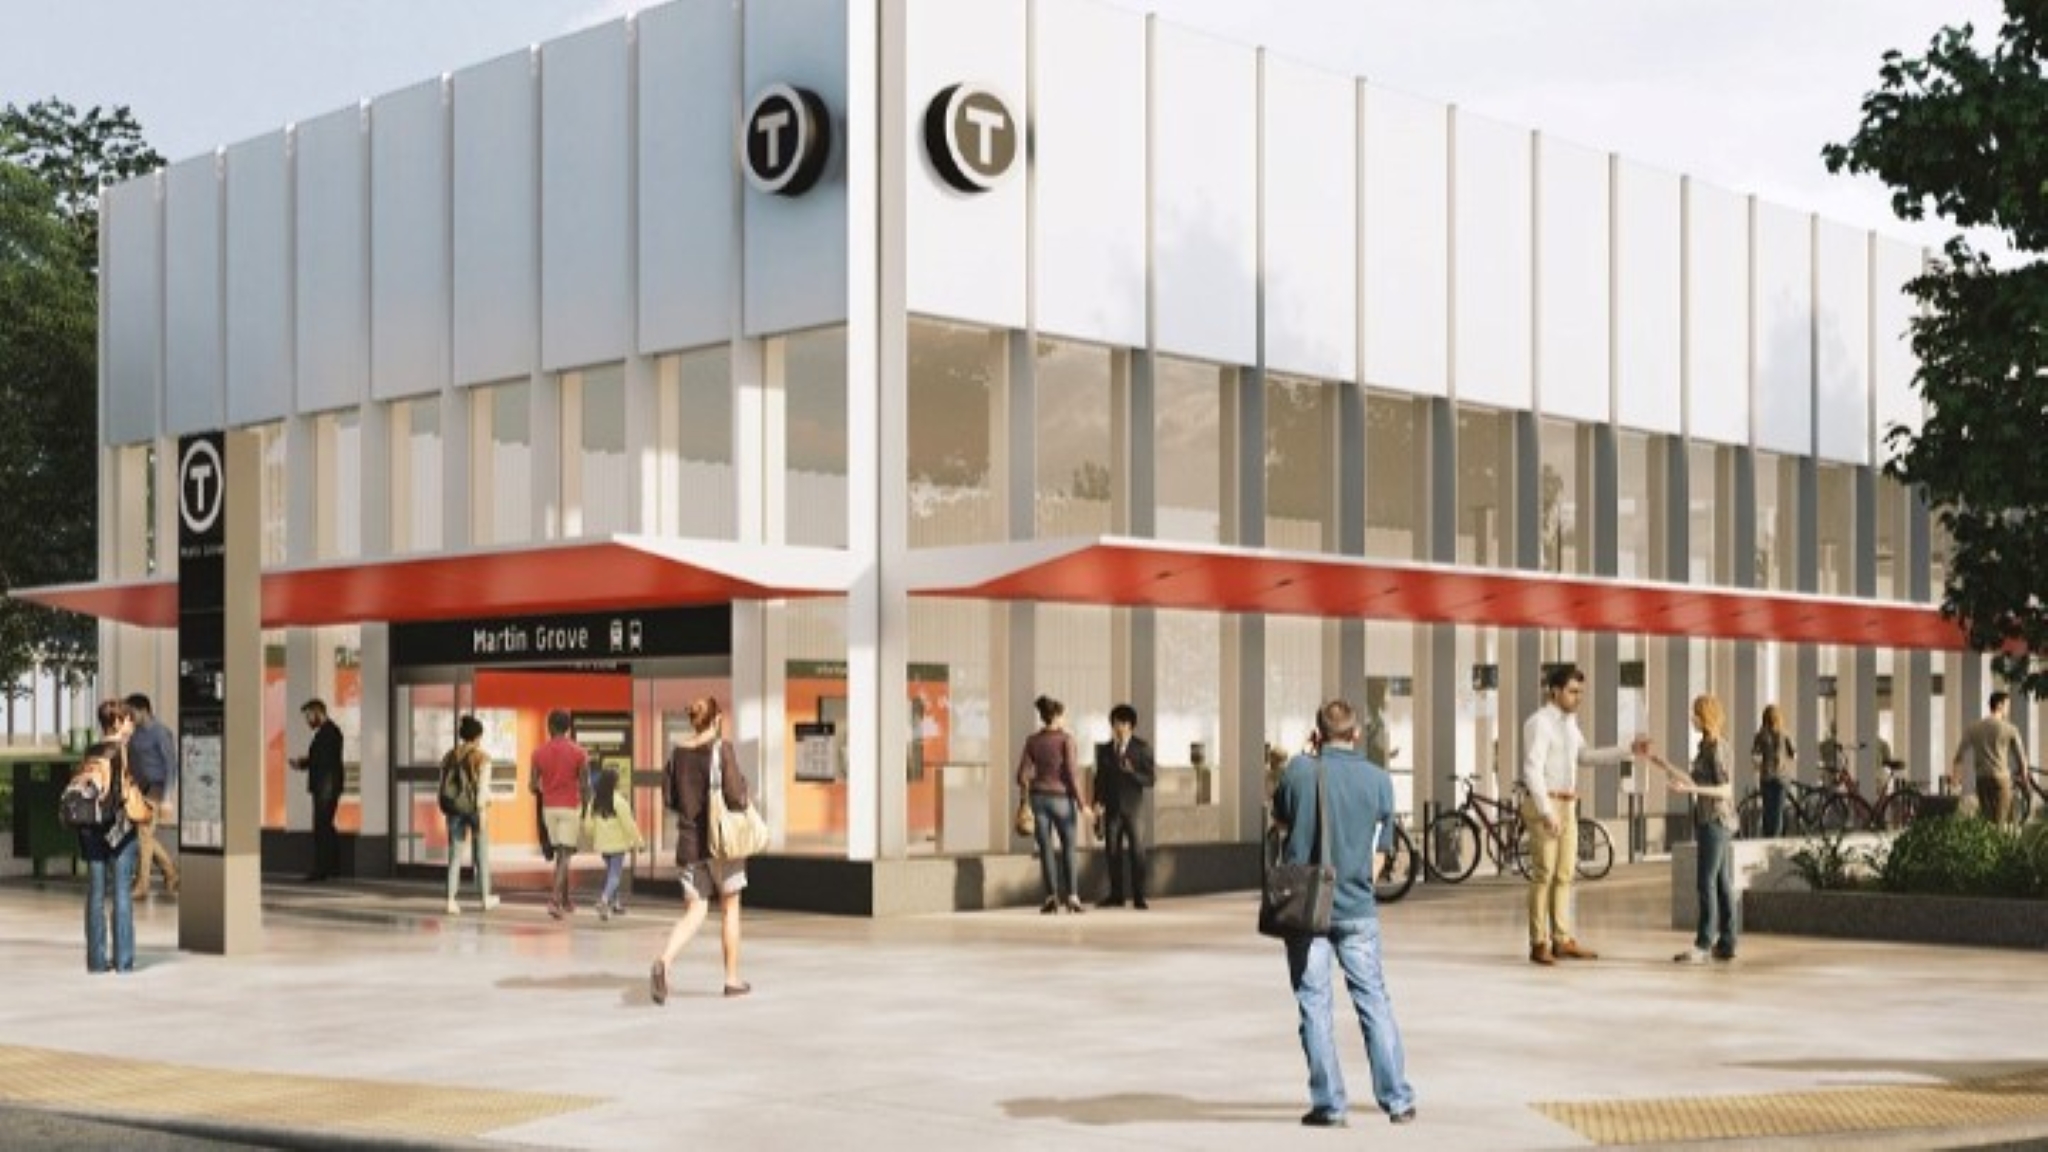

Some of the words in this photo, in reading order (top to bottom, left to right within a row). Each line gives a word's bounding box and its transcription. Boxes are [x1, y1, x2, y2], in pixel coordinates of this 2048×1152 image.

[757, 110, 790, 168] T
[965, 106, 1004, 166] T
[189, 465, 211, 512] T
[473, 624, 528, 653] Martin
[536, 625, 589, 651] Grove
